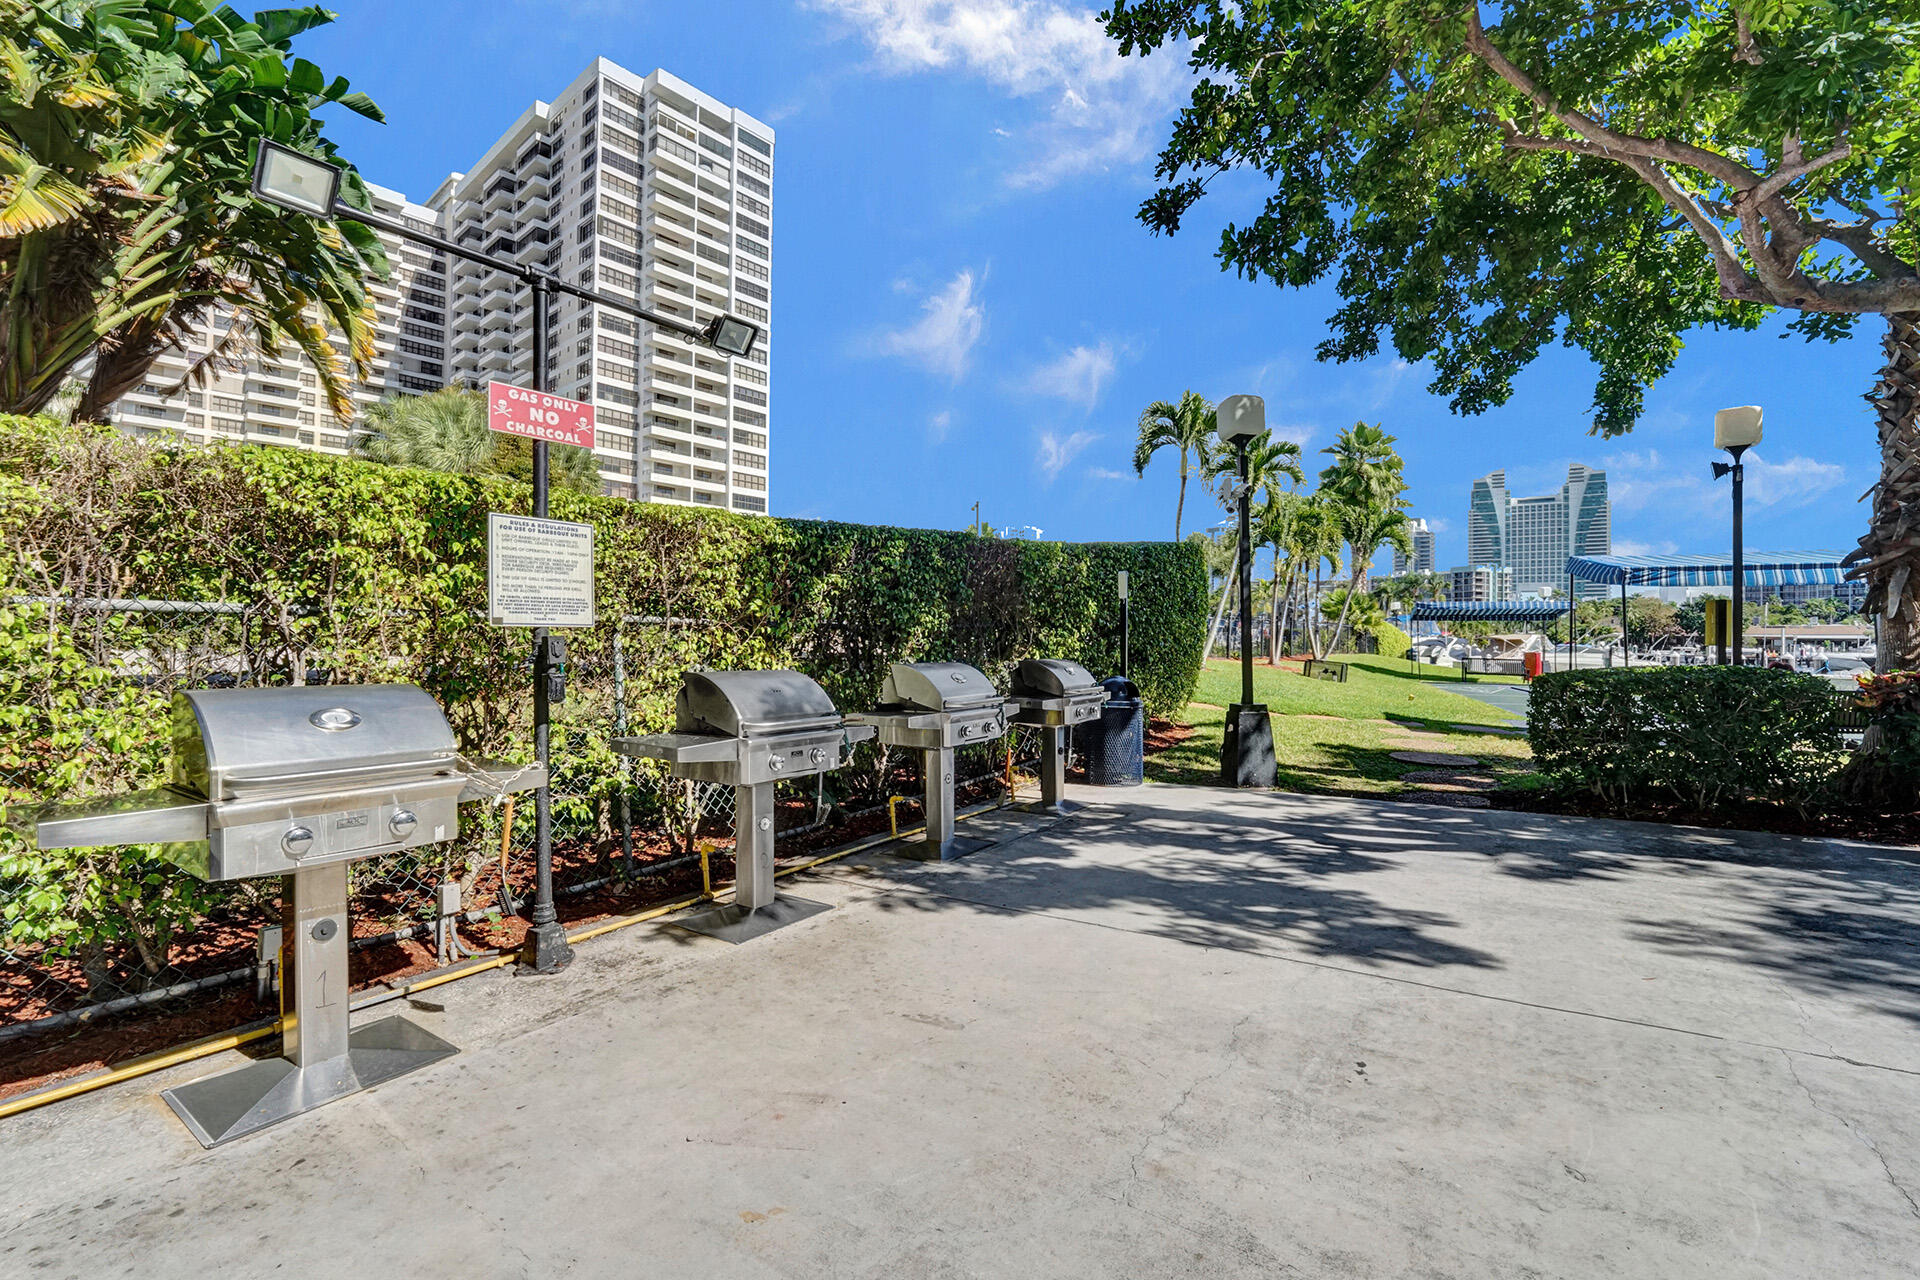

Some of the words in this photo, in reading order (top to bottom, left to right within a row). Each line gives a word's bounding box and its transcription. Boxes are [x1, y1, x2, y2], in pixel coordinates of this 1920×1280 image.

[508, 389, 538, 404] GAS
[542, 397, 579, 413] ONLY
[529, 408, 560, 426] NO
[506, 421, 581, 444] CHARCOAL
[538, 523, 579, 532] REGULATIONS
[315, 970, 337, 1009] 1
